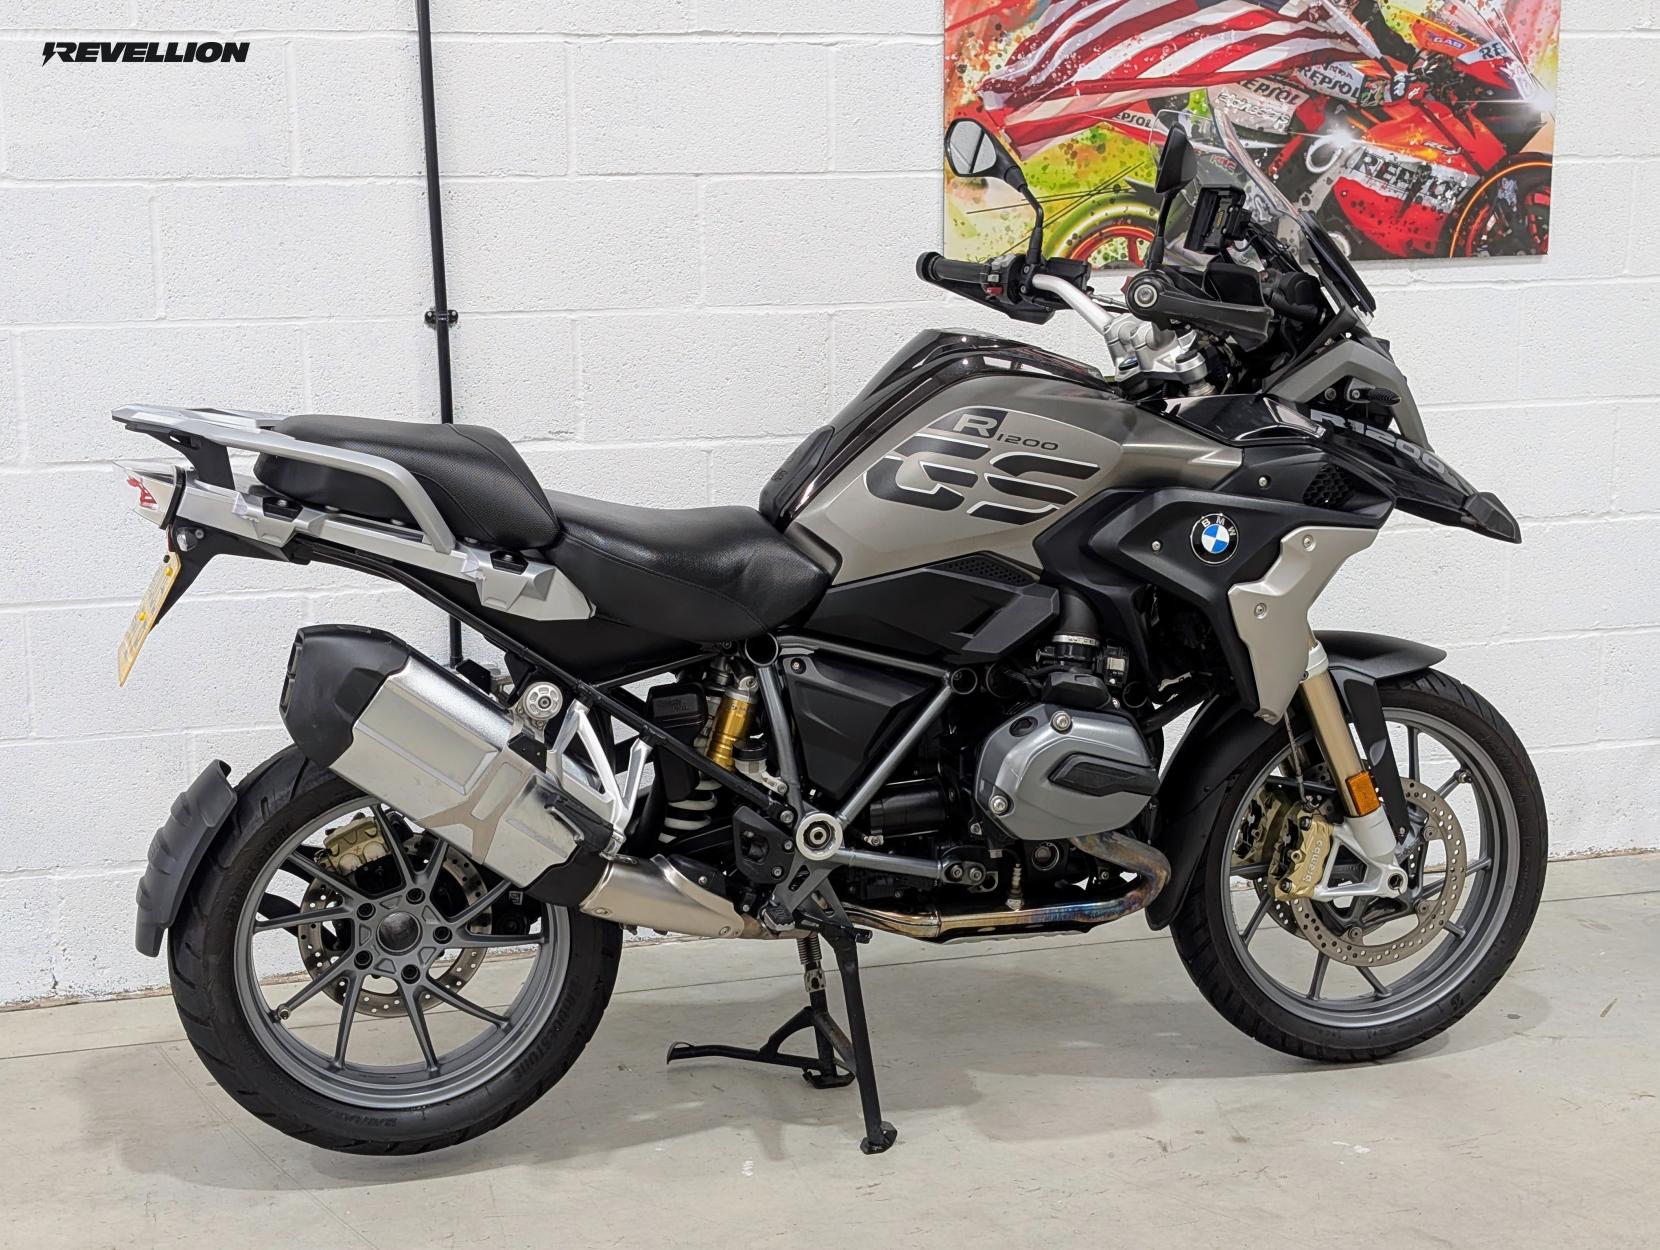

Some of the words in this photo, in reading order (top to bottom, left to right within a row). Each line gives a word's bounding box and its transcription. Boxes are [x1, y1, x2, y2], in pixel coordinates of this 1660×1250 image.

[1238, 79, 1300, 105] EPSOL
[1298, 66, 1361, 98] REPSOL
[953, 413, 998, 438] R
[997, 433, 1059, 451] 1200
[863, 432, 1101, 526] GS
[1201, 515, 1236, 536] BMW
[1302, 840, 1324, 883] brembo
